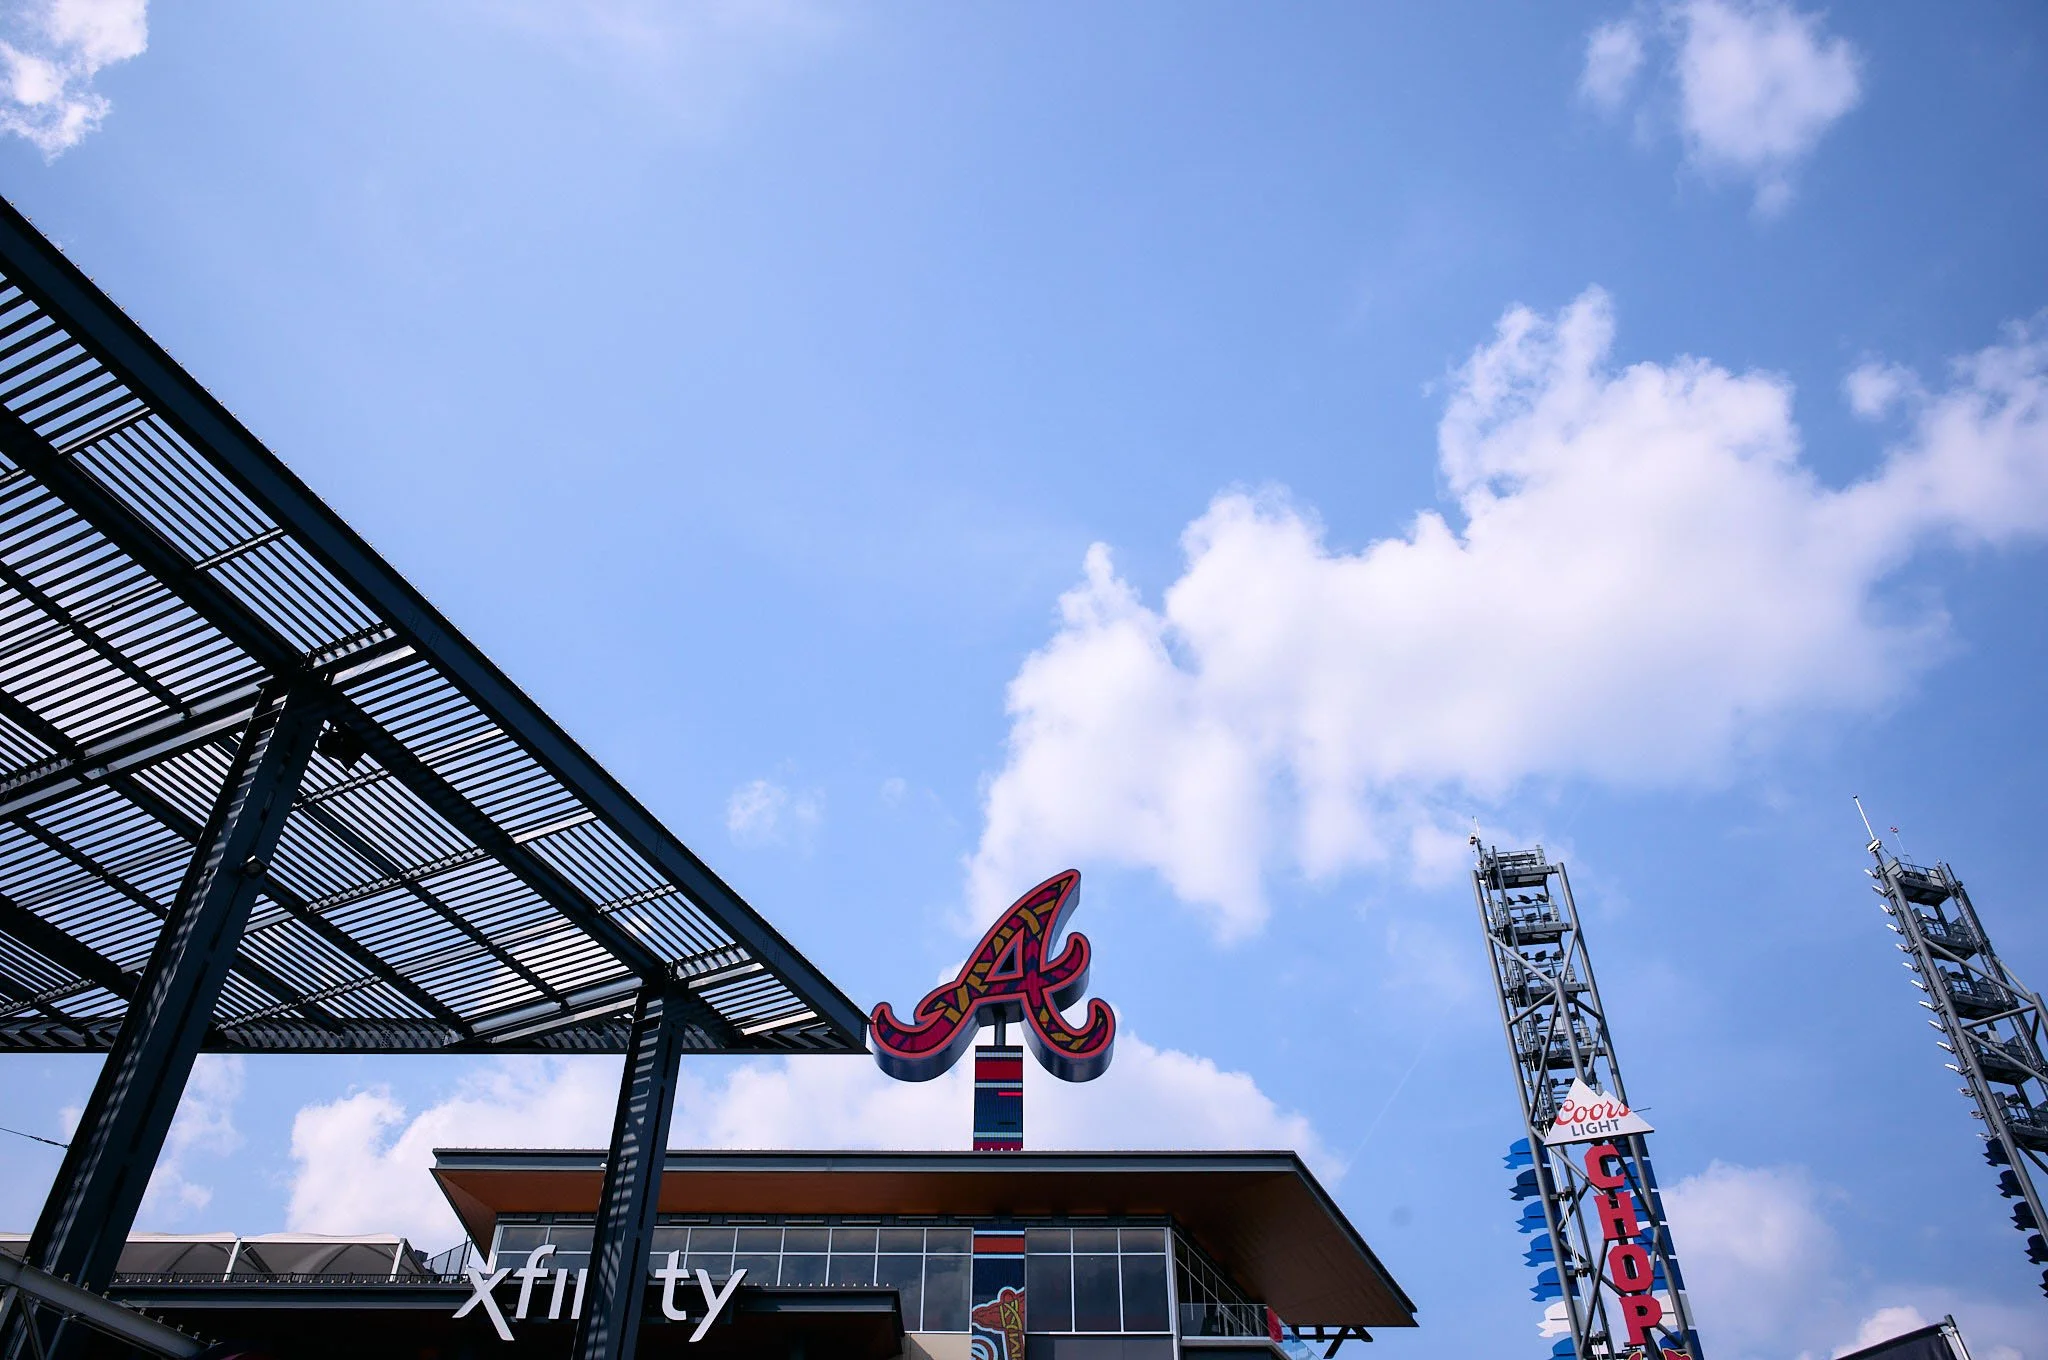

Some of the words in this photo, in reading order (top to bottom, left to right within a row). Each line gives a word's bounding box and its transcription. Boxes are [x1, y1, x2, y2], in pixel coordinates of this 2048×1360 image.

[869, 868, 1117, 1082] A
[1555, 1099, 1631, 1126] Coors
[1571, 1119, 1620, 1137] LIGHT
[451, 1244, 748, 1342] xfity
[1584, 1144, 1663, 1346] CHOP
